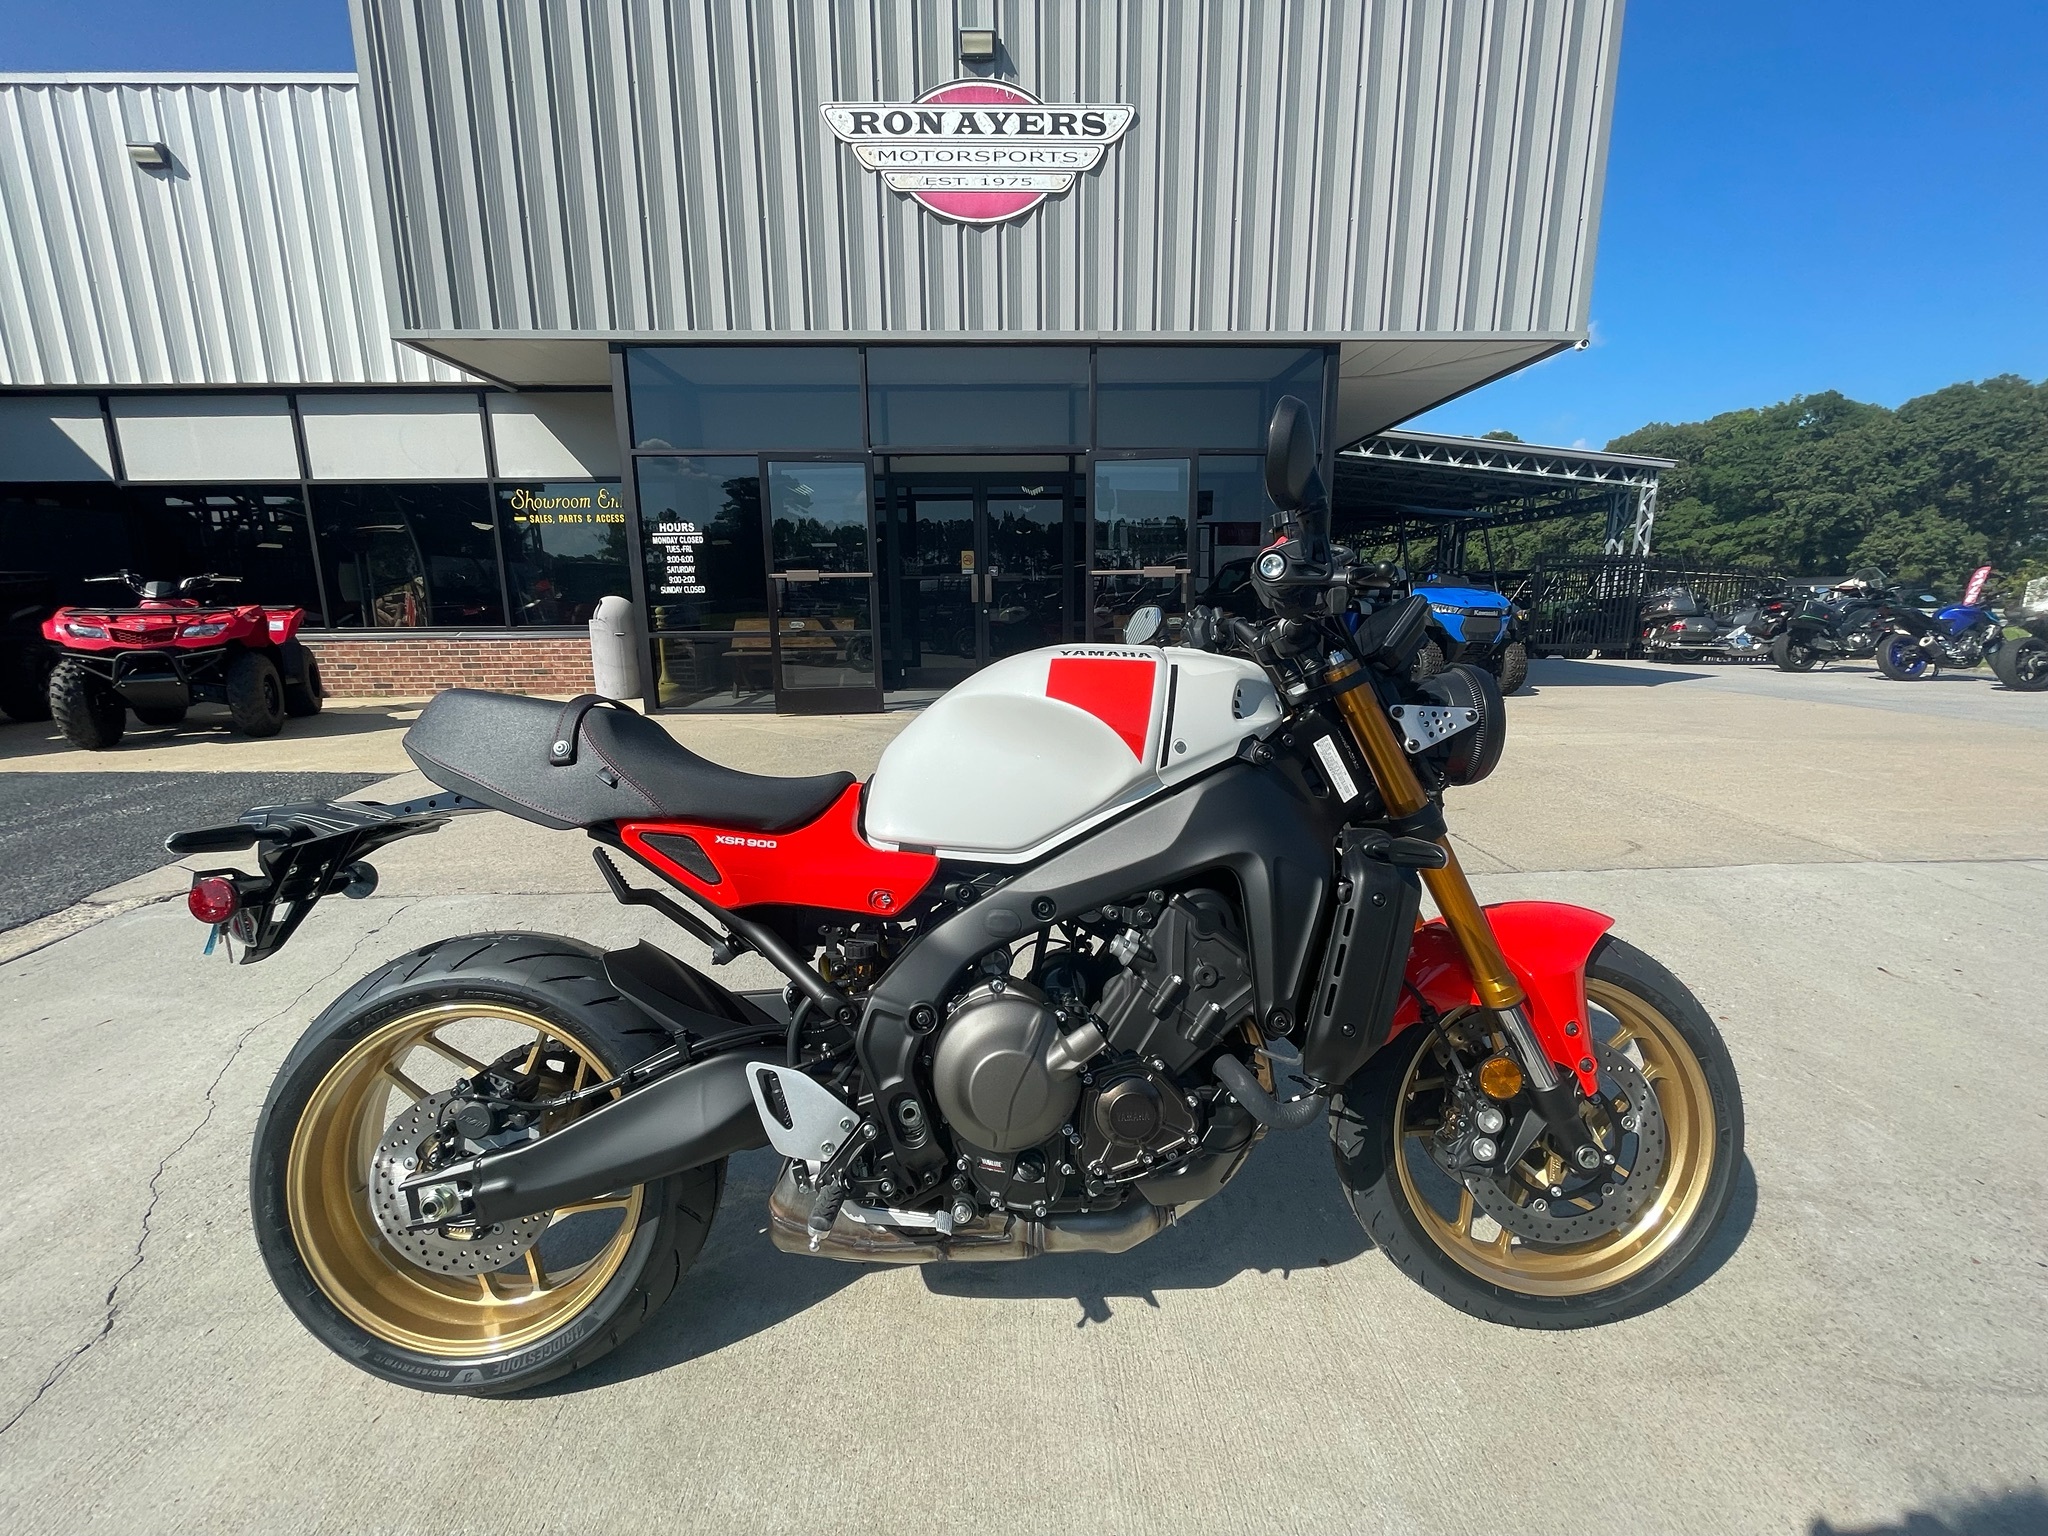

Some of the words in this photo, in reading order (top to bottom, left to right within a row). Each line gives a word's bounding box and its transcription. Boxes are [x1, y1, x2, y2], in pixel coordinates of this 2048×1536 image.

[849, 111, 945, 135] RON
[952, 111, 1107, 136] AYERS
[877, 149, 1079, 163] MOTORSPORTS
[925, 177, 969, 186] EST.
[981, 177, 1033, 186] 1975
[511, 488, 592, 511] Showroom
[529, 514, 556, 524] SALES,
[558, 514, 583, 523] PARTS
[586, 514, 592, 523] &
[658, 522, 695, 532] HOURS
[652, 536, 678, 544] MONDAY
[679, 536, 704, 544] CLOSED
[666, 565, 696, 573] SATURDAY
[668, 575, 696, 584] 9:00-2:00
[660, 586, 683, 594] SUNDAY
[683, 585, 706, 594] CLOSED
[1060, 650, 1152, 658] YAMAHA
